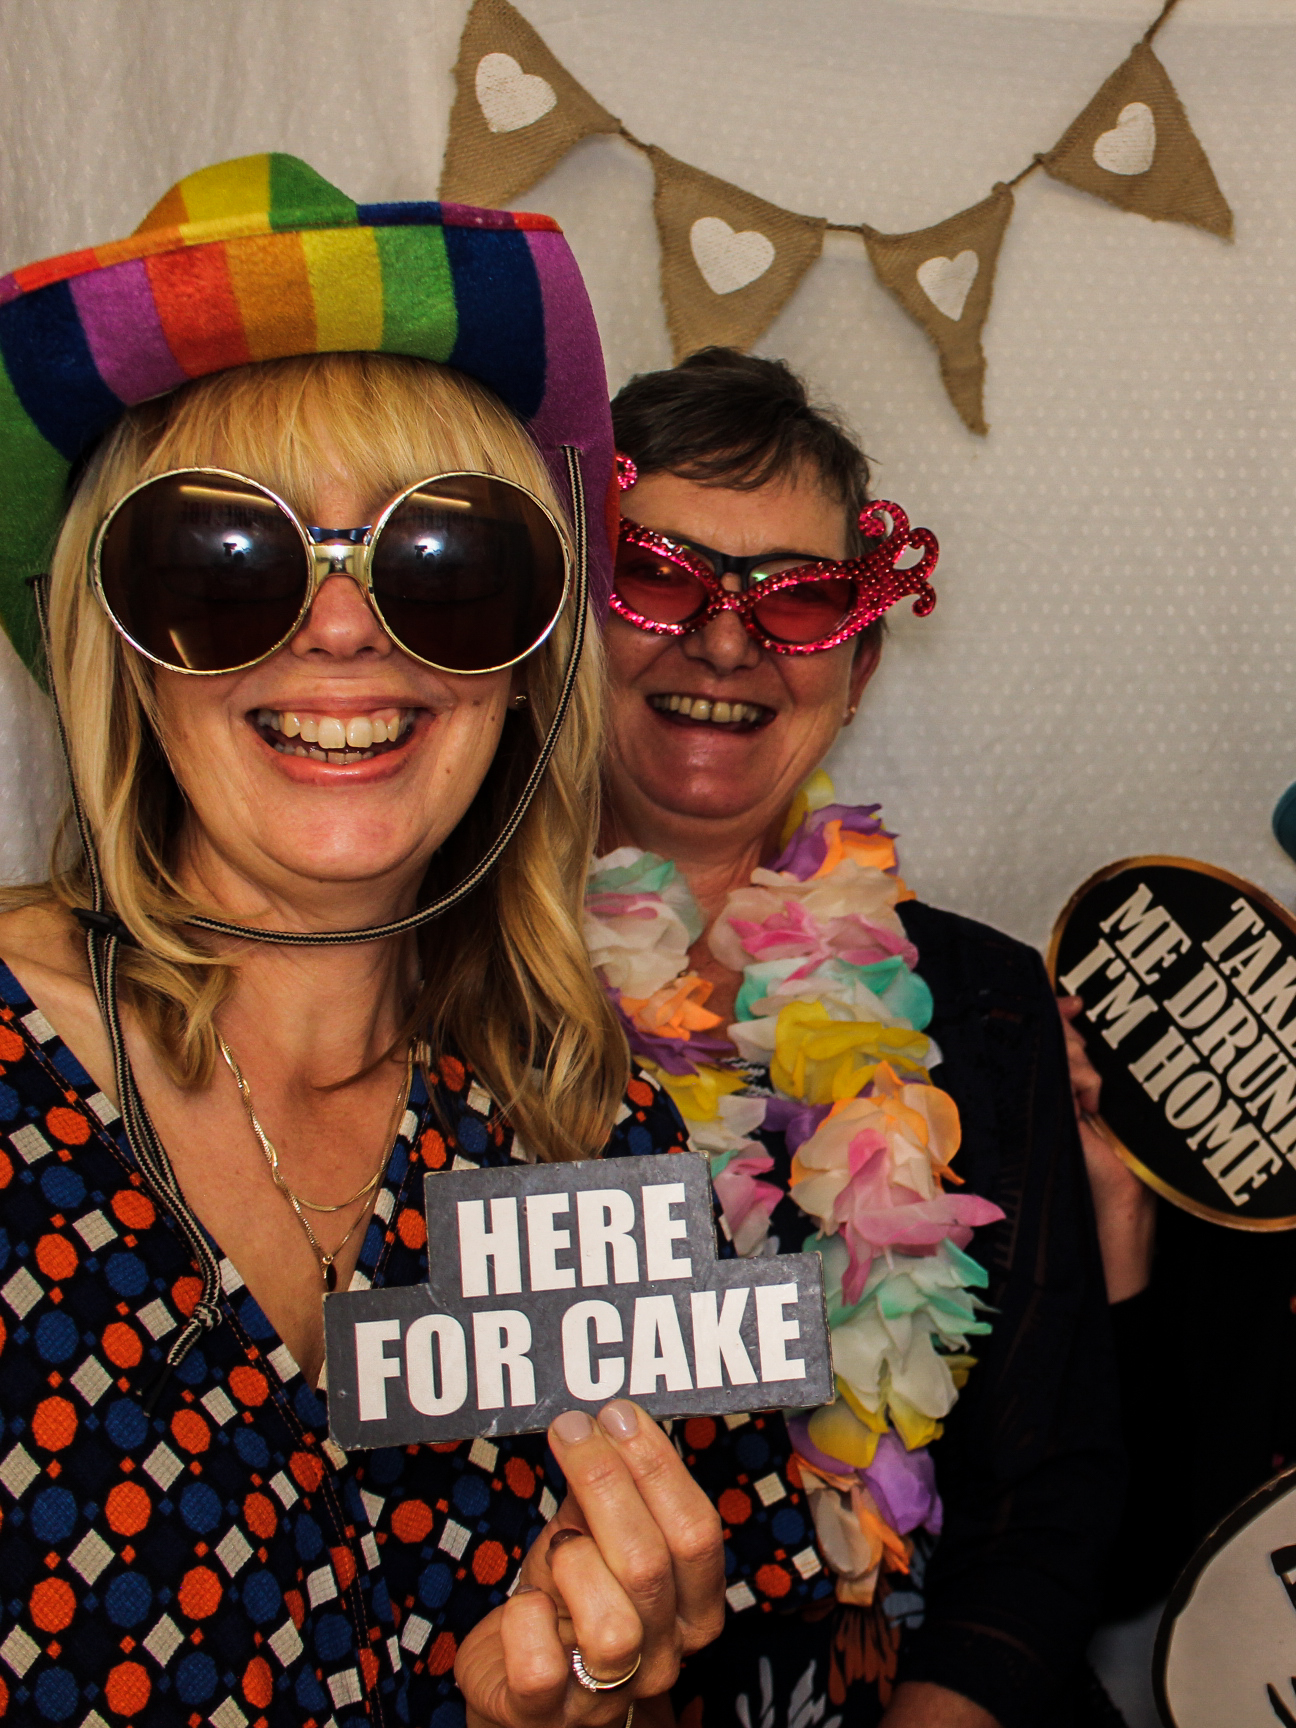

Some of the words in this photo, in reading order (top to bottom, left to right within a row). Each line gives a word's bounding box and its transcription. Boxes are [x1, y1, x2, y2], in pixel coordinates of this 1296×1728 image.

[1099, 882, 1192, 985] ME
[1059, 938, 1158, 1049] I'M
[1128, 1025, 1283, 1206] HOME
[456, 1182, 693, 1298] HERE
[355, 1309, 537, 1421] FOR
[561, 1282, 807, 1401] CAKE
